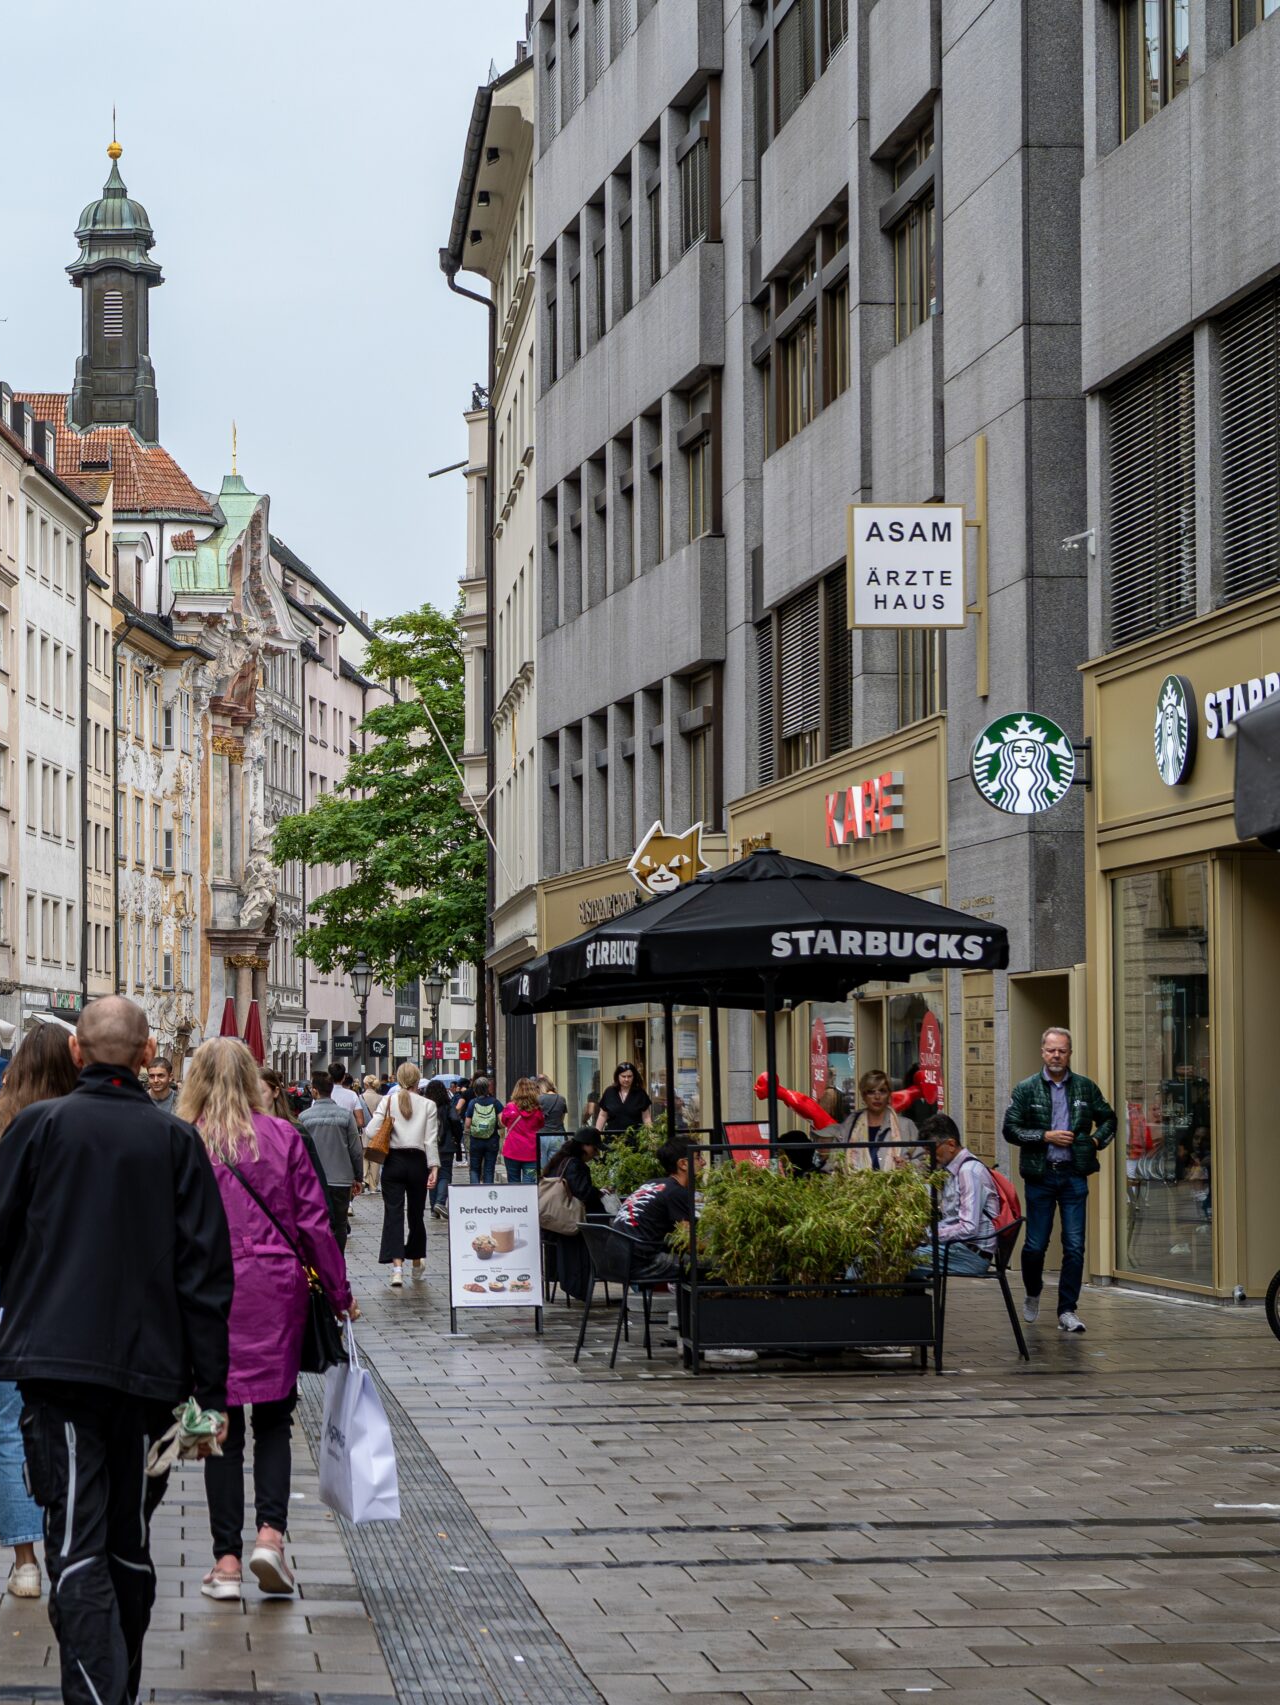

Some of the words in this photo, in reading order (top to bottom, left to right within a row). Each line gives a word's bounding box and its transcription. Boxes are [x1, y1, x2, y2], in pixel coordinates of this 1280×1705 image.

[865, 521, 952, 542] ASAM
[866, 567, 952, 586] ÄRZTE
[874, 594, 945, 610] HAUS
[825, 770, 903, 848] KARE
[771, 929, 984, 961] STARBUCKS
[924, 1070, 937, 1084] SALE
[460, 1206, 498, 1215] Perfectly
[500, 1205, 528, 1213] Paired
